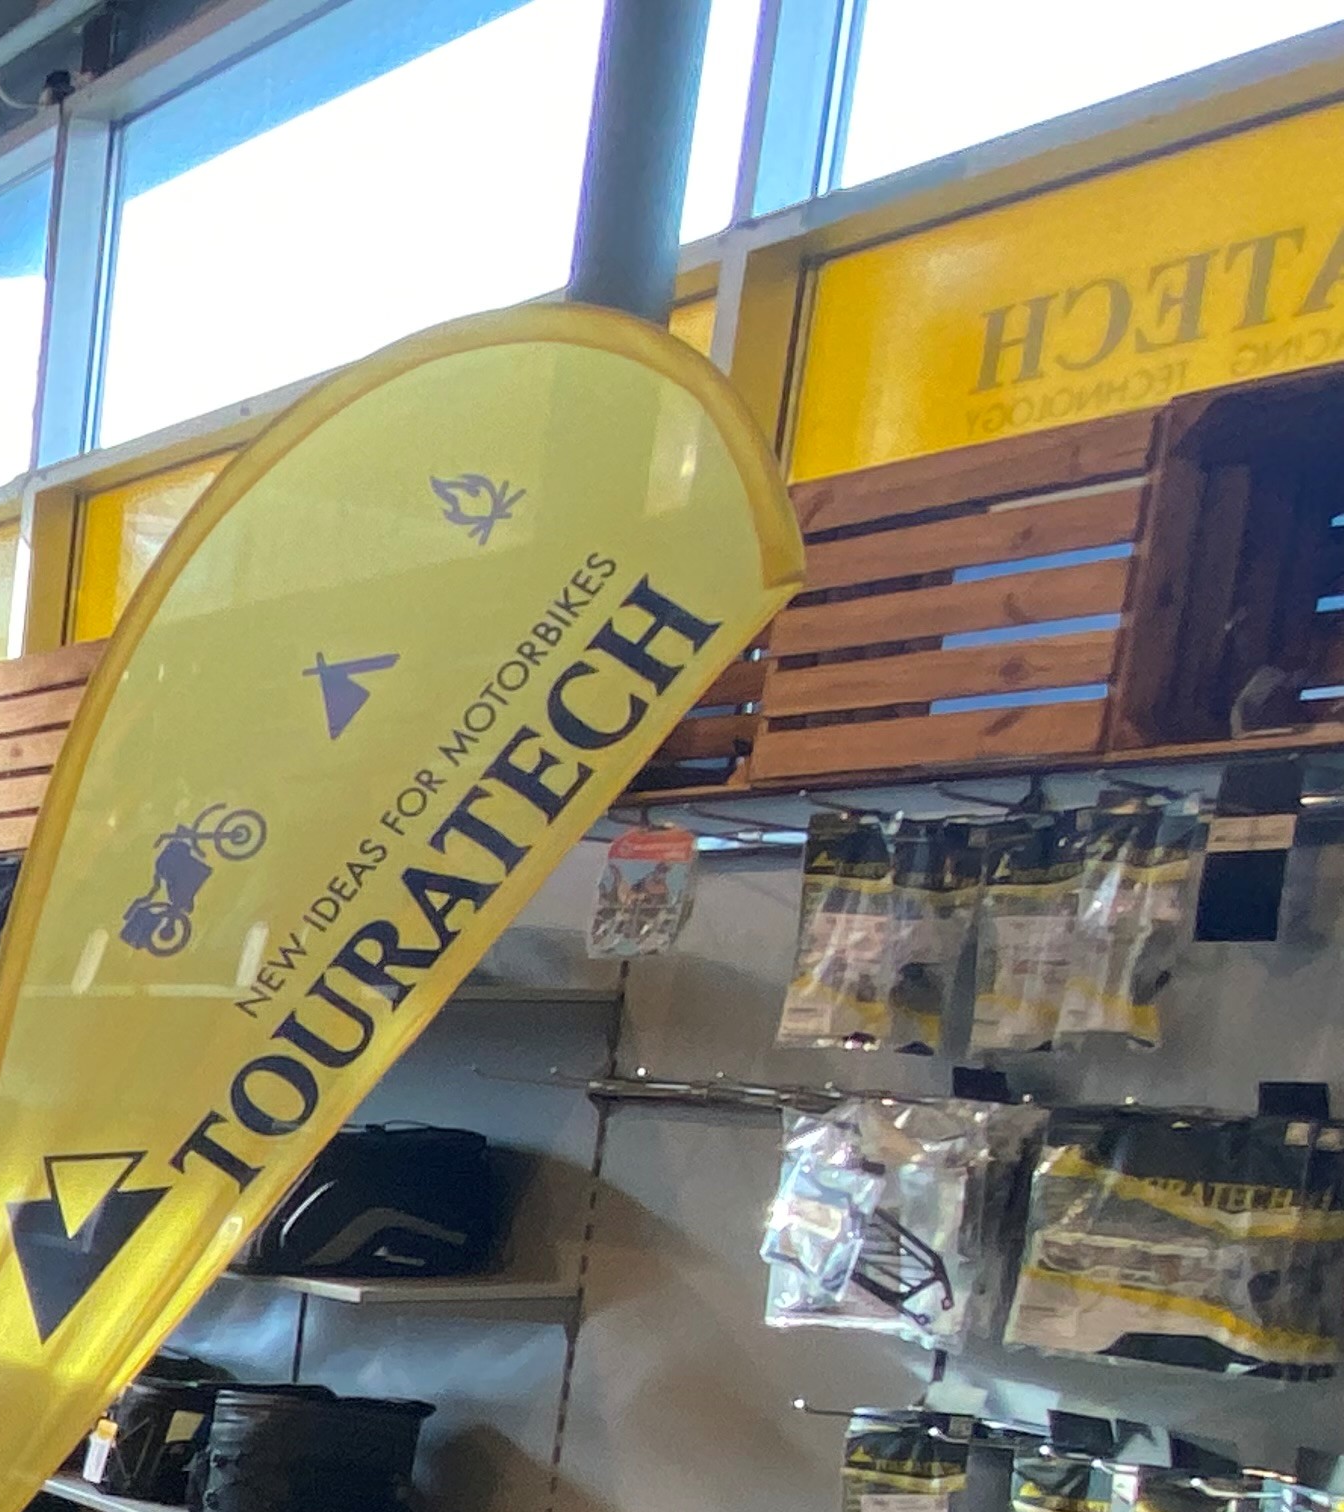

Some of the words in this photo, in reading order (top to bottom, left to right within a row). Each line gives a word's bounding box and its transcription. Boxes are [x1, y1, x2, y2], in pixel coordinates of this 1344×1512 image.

[169, 572, 725, 1192] TOURATECH
[234, 932, 309, 1019] NEW
[302, 838, 388, 934] IDEAS
[381, 767, 448, 837] FOR
[438, 551, 618, 768] MOTORBIKES
